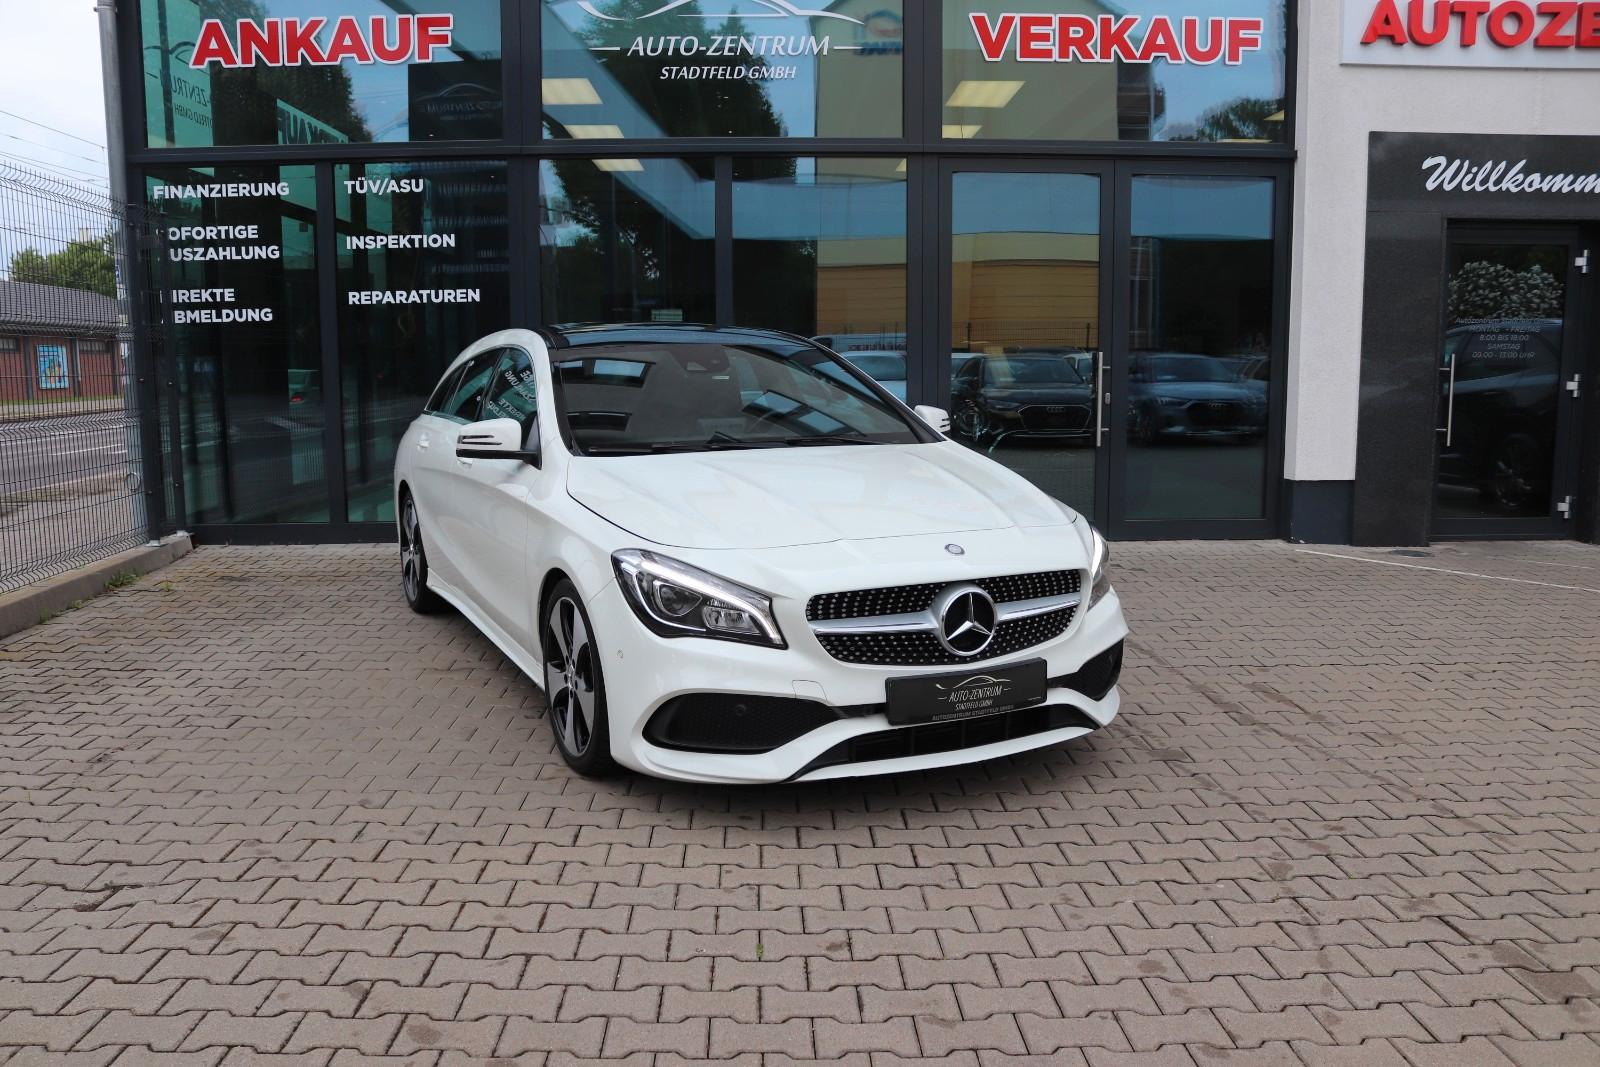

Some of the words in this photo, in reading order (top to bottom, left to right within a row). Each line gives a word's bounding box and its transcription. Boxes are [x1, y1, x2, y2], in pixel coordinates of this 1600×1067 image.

[189, 13, 453, 68] ANKAUF
[627, 35, 830, 57] AUTO-ZENTRUM
[969, 12, 1263, 65] VERKAUF
[660, 66, 744, 80] STADTFELD
[749, 66, 796, 79] GMBH
[153, 182, 290, 200] FINANZIERUNG
[343, 177, 424, 196] TÜV/ASU
[156, 224, 259, 241] OFORTIGE
[346, 233, 456, 250] INSPEKTION
[158, 246, 280, 262] USZAHLUNG
[160, 288, 236, 303] IREKTE
[348, 288, 481, 305] REPARATUREN
[161, 308, 273, 325] BMELDUNG
[949, 685, 1003, 703] AUTO-ZENTRUM
